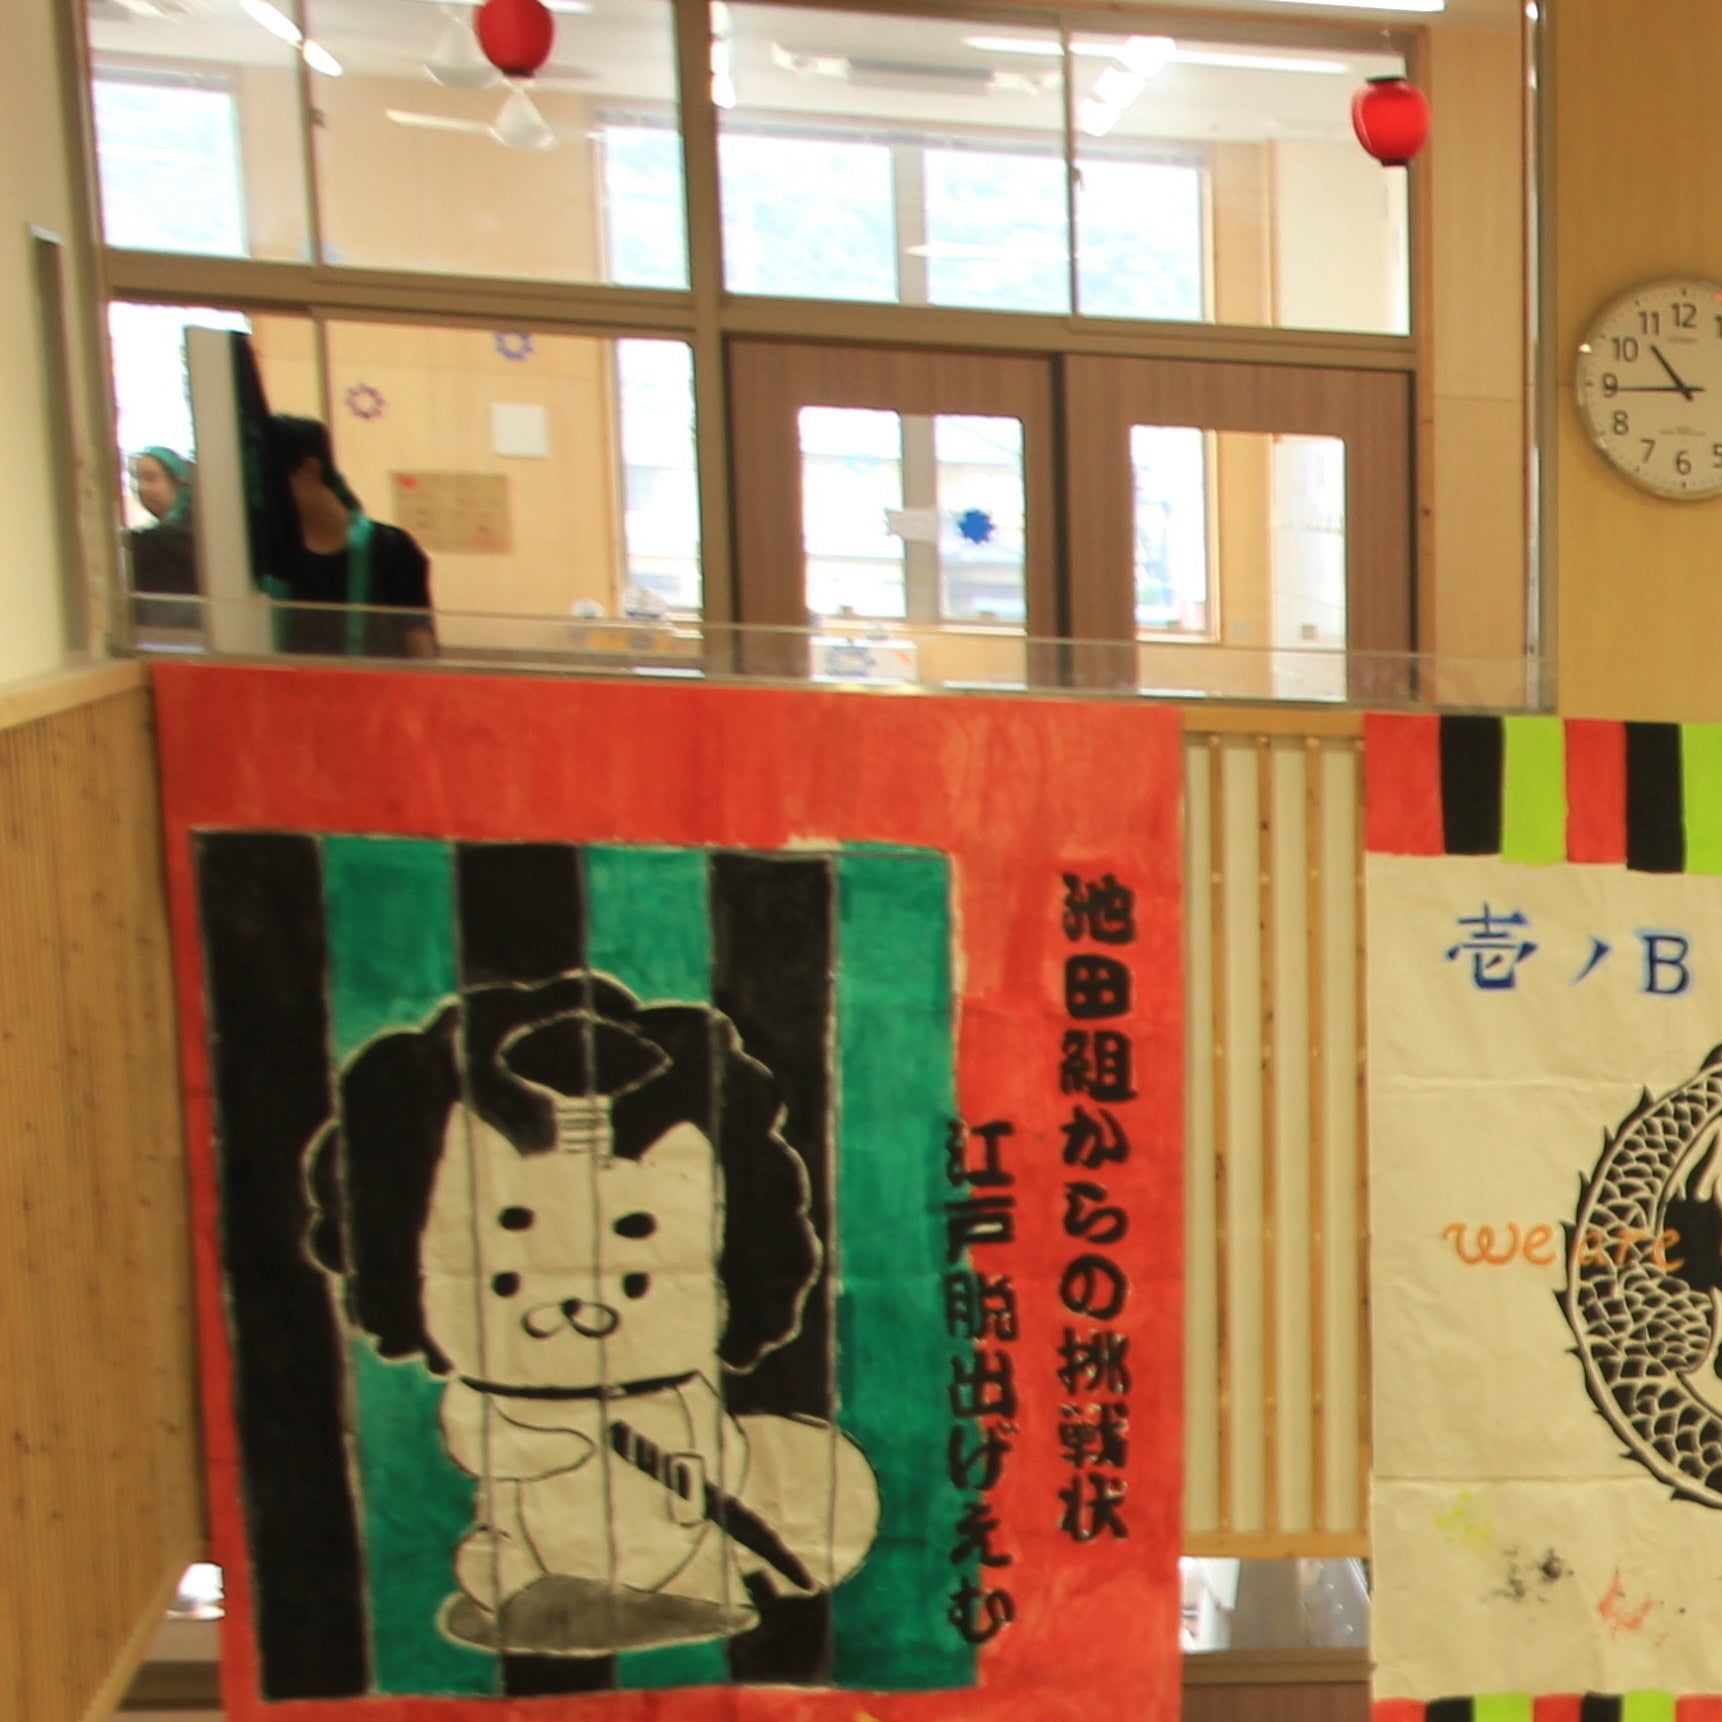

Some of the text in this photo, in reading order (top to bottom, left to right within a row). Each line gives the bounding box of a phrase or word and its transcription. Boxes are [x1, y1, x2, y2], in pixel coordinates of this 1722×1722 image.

[1638, 311, 1660, 336] 11
[1671, 303, 1697, 328] 12
[1611, 337, 1639, 362] 10
[1602, 372, 1618, 398] 9
[1612, 410, 1629, 435] 8
[1640, 438, 1656, 464] 7
[1676, 450, 1692, 475] 6
[1060, 871, 1136, 1542] 池田組からの挑戦状
[1441, 1219, 1557, 1266] we
[1572, 1225, 1684, 1271] are
